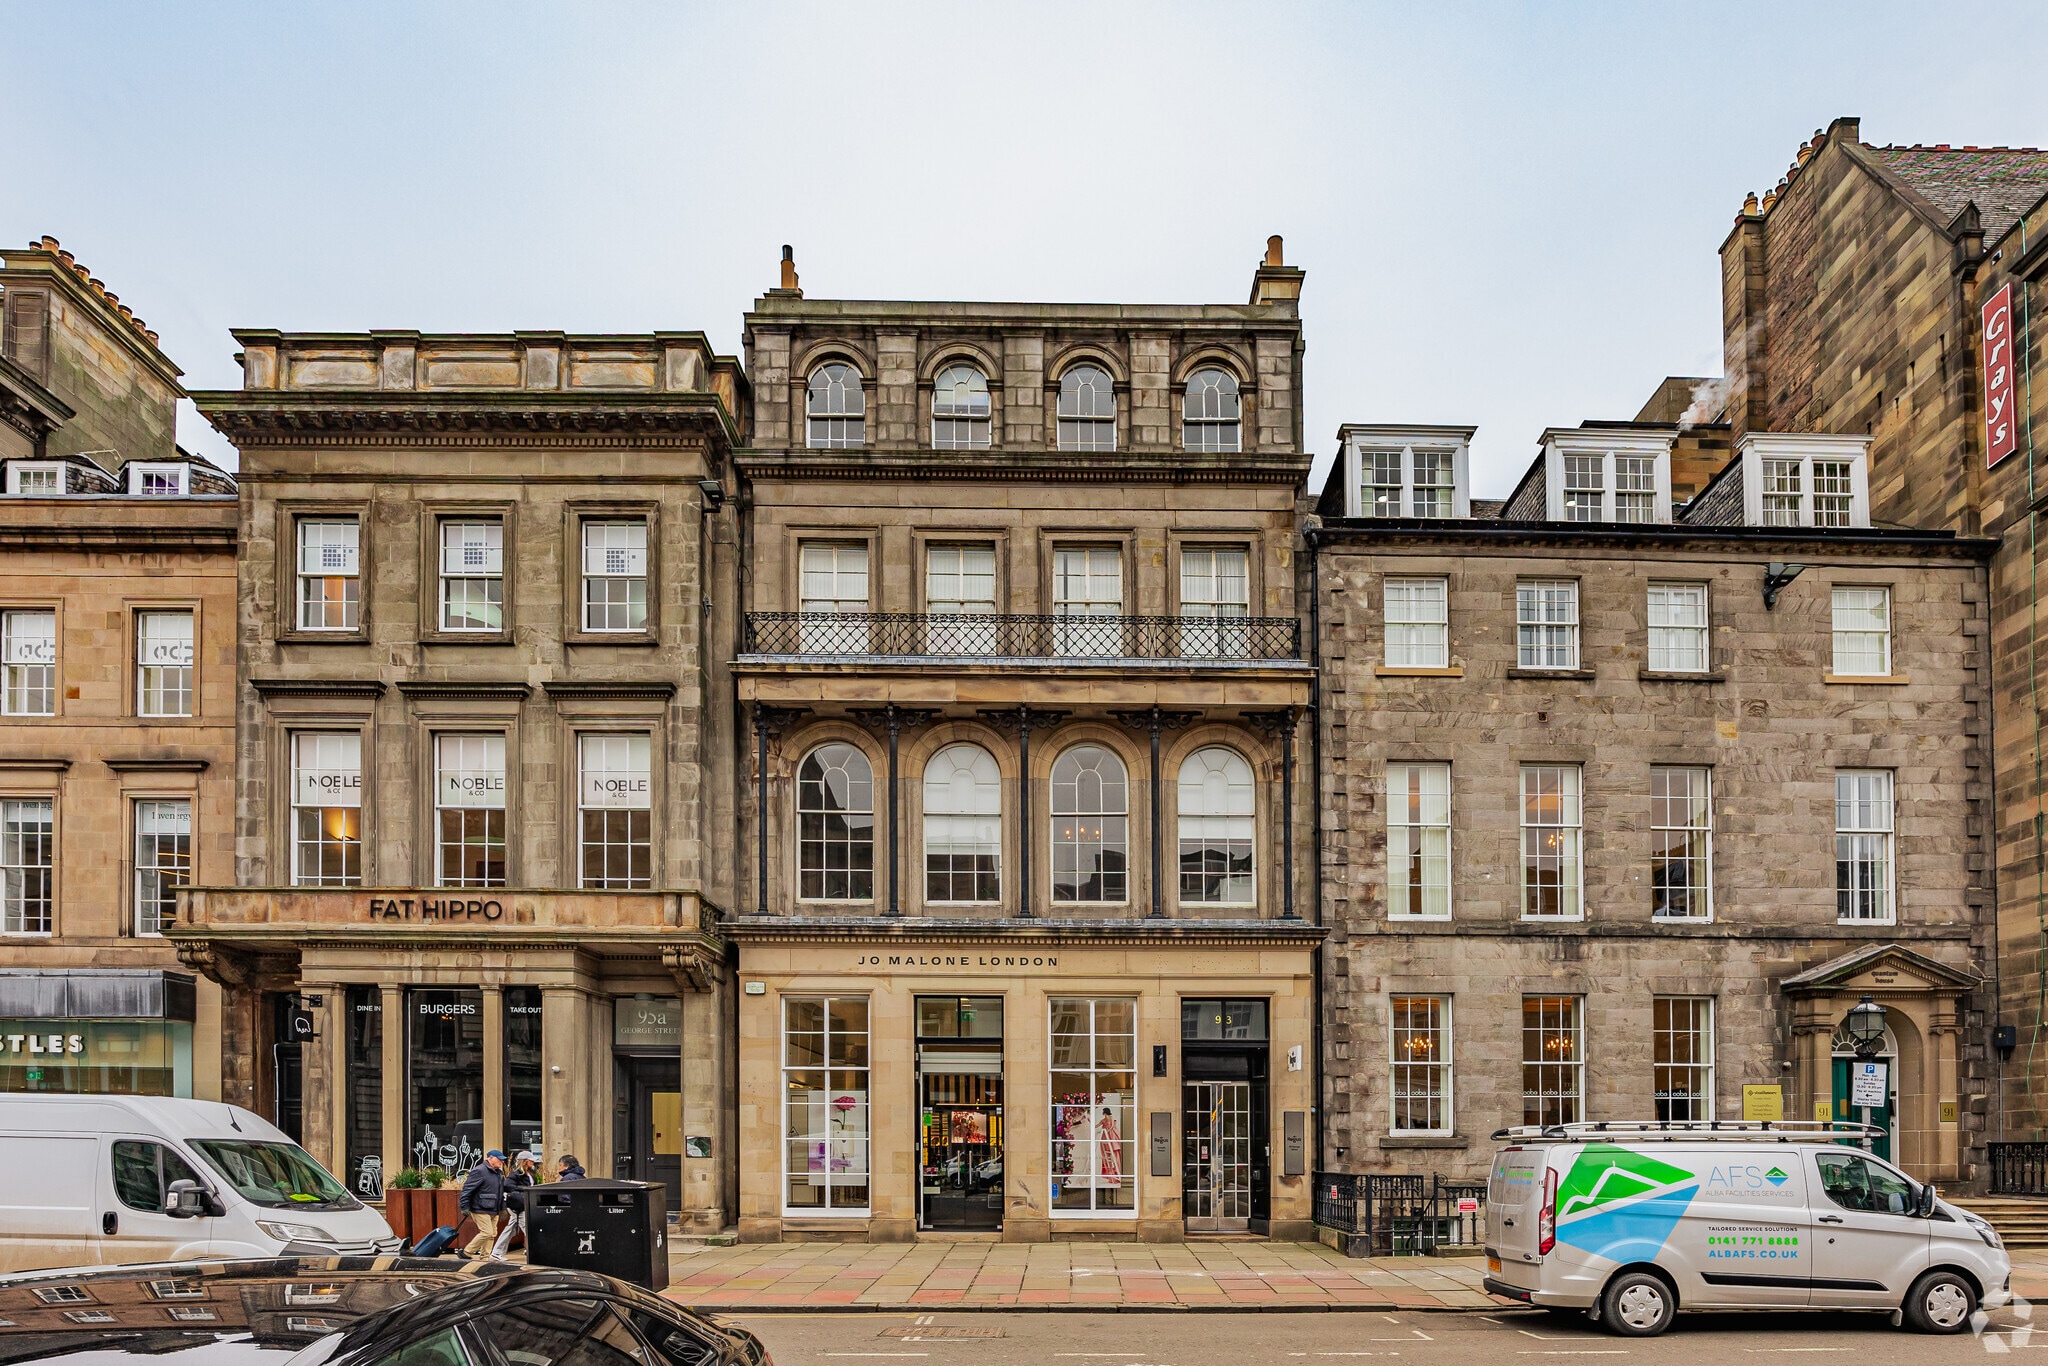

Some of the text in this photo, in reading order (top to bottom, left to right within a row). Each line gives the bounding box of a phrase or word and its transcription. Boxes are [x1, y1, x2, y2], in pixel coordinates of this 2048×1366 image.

[1986, 306, 2009, 446] Grays
[309, 775, 361, 788] NOBLE
[450, 777, 504, 789] NOBLE
[594, 779, 647, 791] NOBLE
[370, 899, 503, 920] FAT HIPPO
[858, 956, 1058, 966] JO MALONE LONDON
[420, 1004, 475, 1014] BURGERS
[638, 1009, 667, 1025] 95a
[1215, 1015, 1232, 1024] 93
[1867, 1065, 1874, 1073] P
[1818, 1107, 1829, 1116] 91
[1944, 1107, 1954, 1117] 91
[1708, 1166, 1763, 1188] AFS
[1708, 1236, 1799, 1245] 0141 771 8888
[1708, 1249, 1798, 1258] ALBAFS.CO.UK
